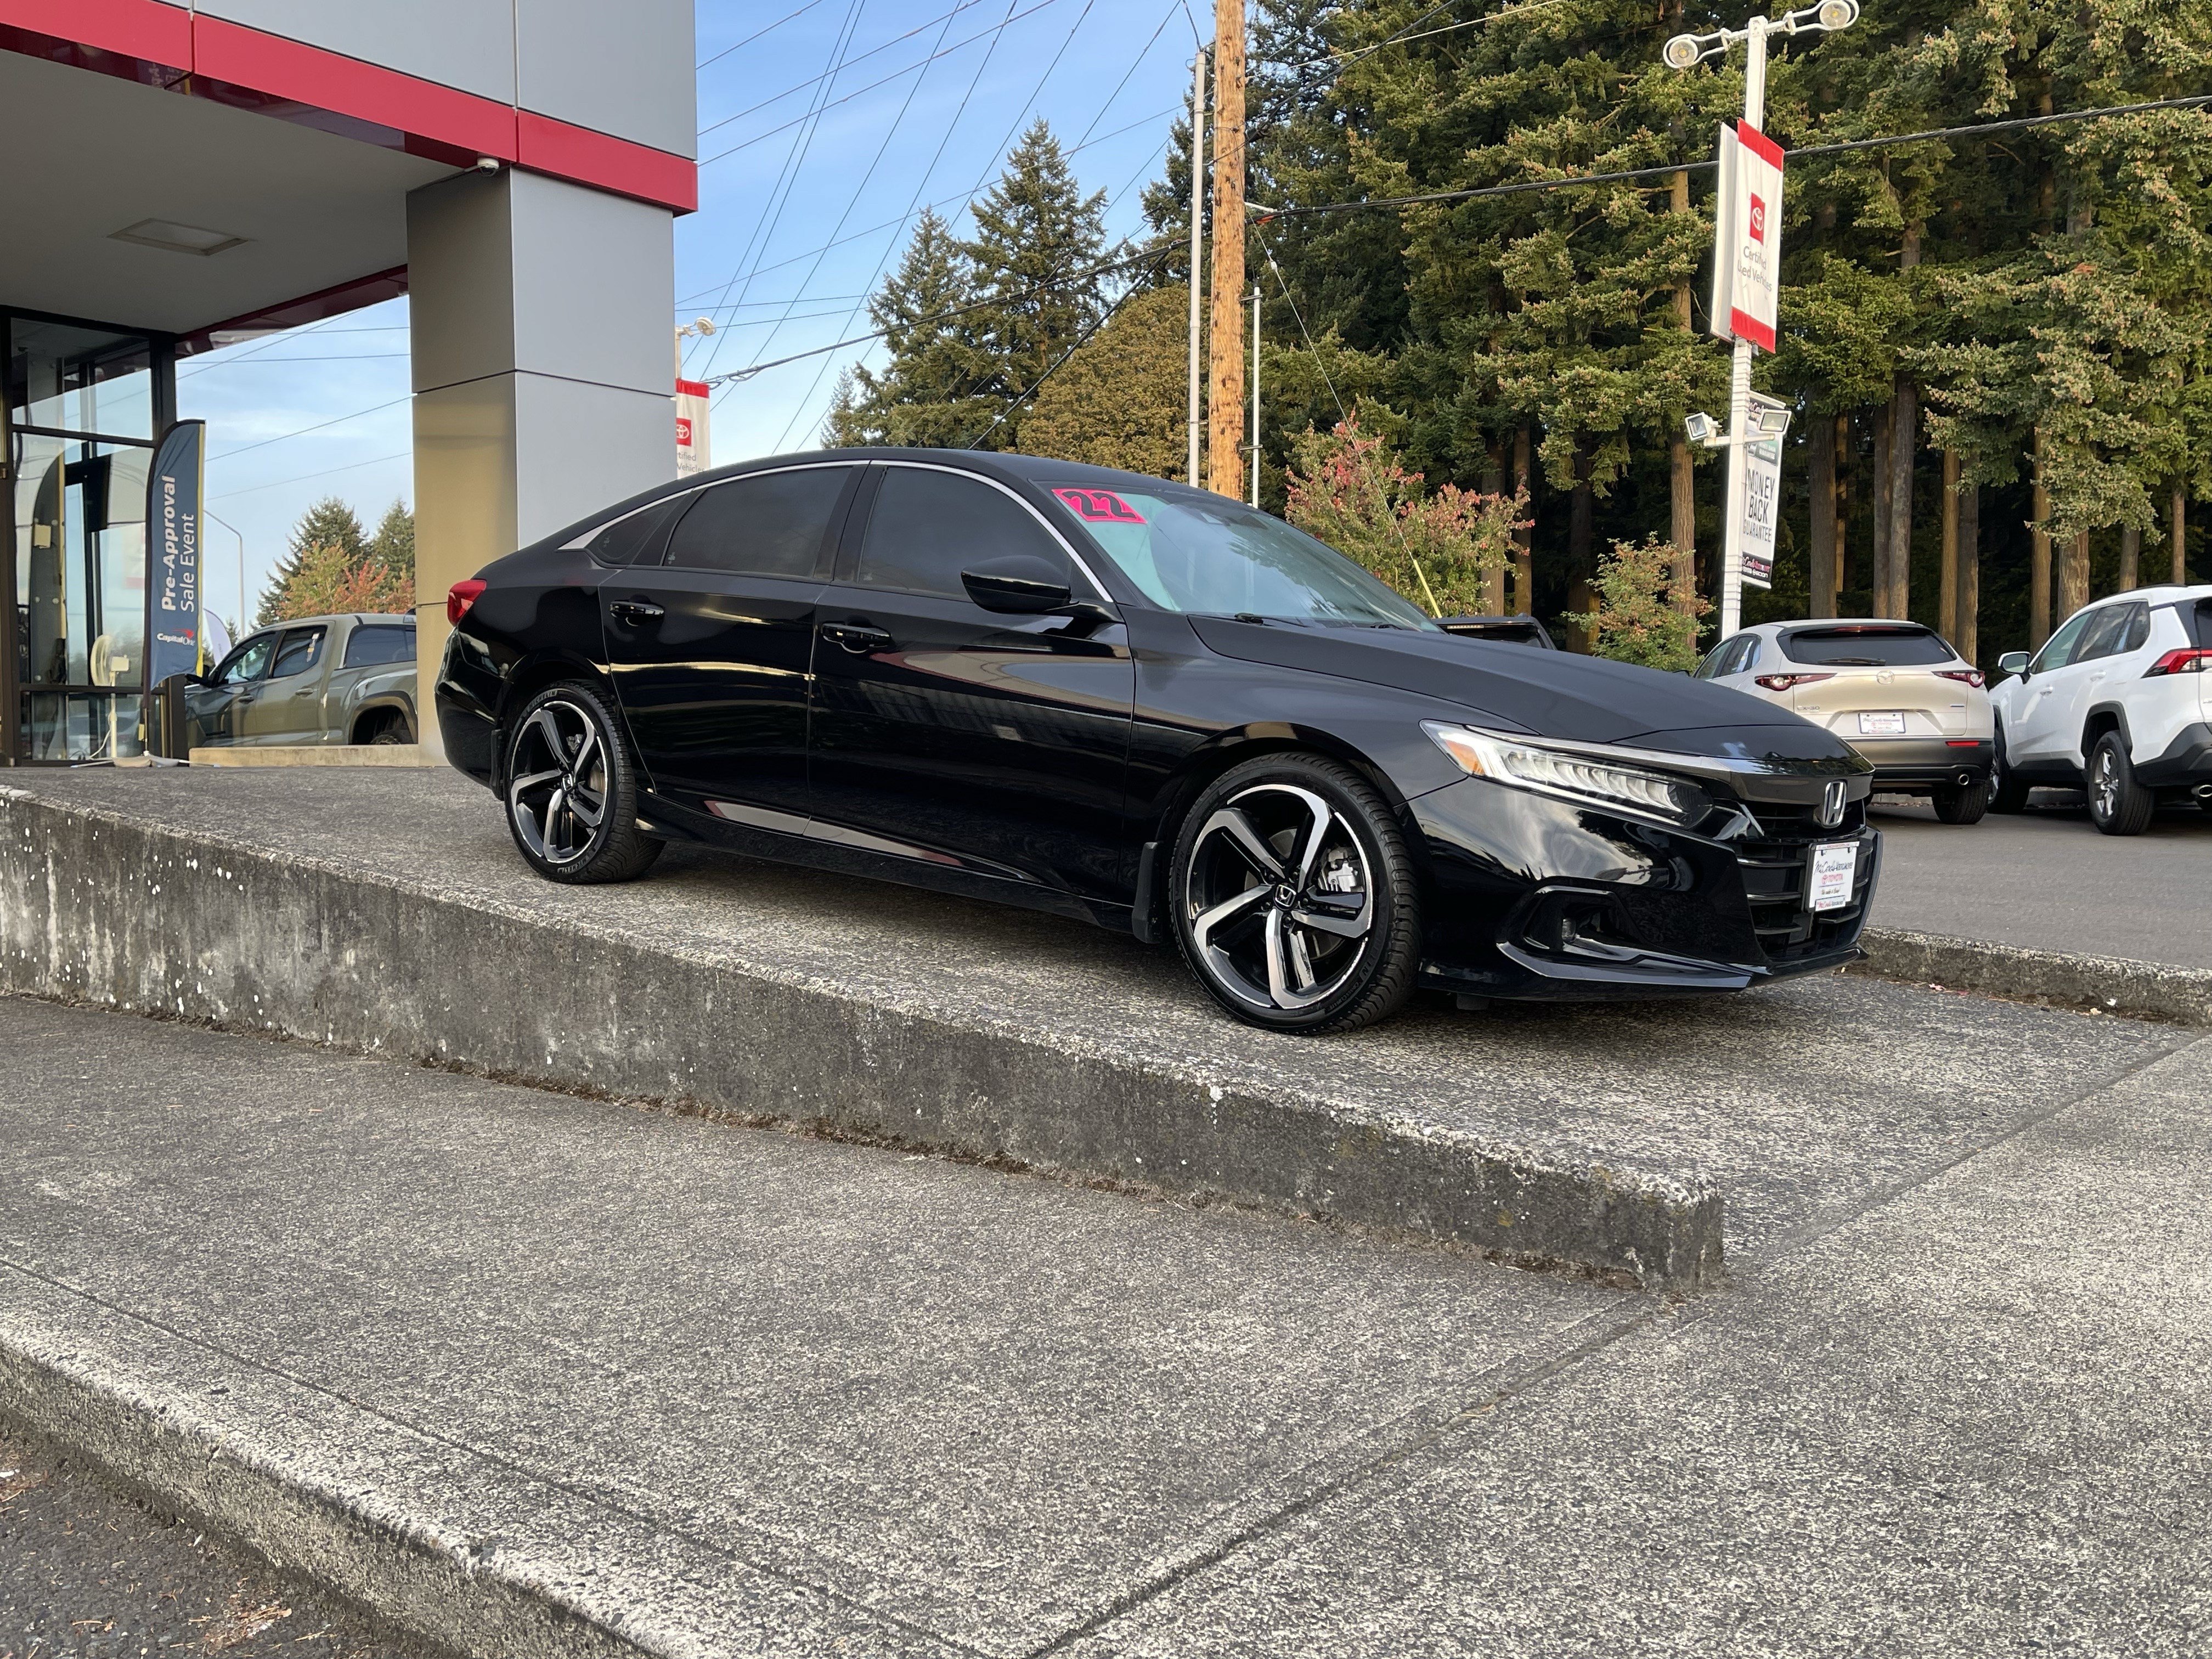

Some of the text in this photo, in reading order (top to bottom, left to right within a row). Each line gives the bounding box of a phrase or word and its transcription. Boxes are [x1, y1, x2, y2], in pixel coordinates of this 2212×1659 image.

[1737, 259, 1752, 279] Ued
[1747, 467, 1775, 501] MONEY
[1062, 490, 1136, 518] 22
[1748, 494, 1769, 525] BACK
[161, 475, 179, 611] Pre-Approval
[1743, 518, 1772, 543] GUARANTEE
[179, 513, 195, 613] Sale Event
